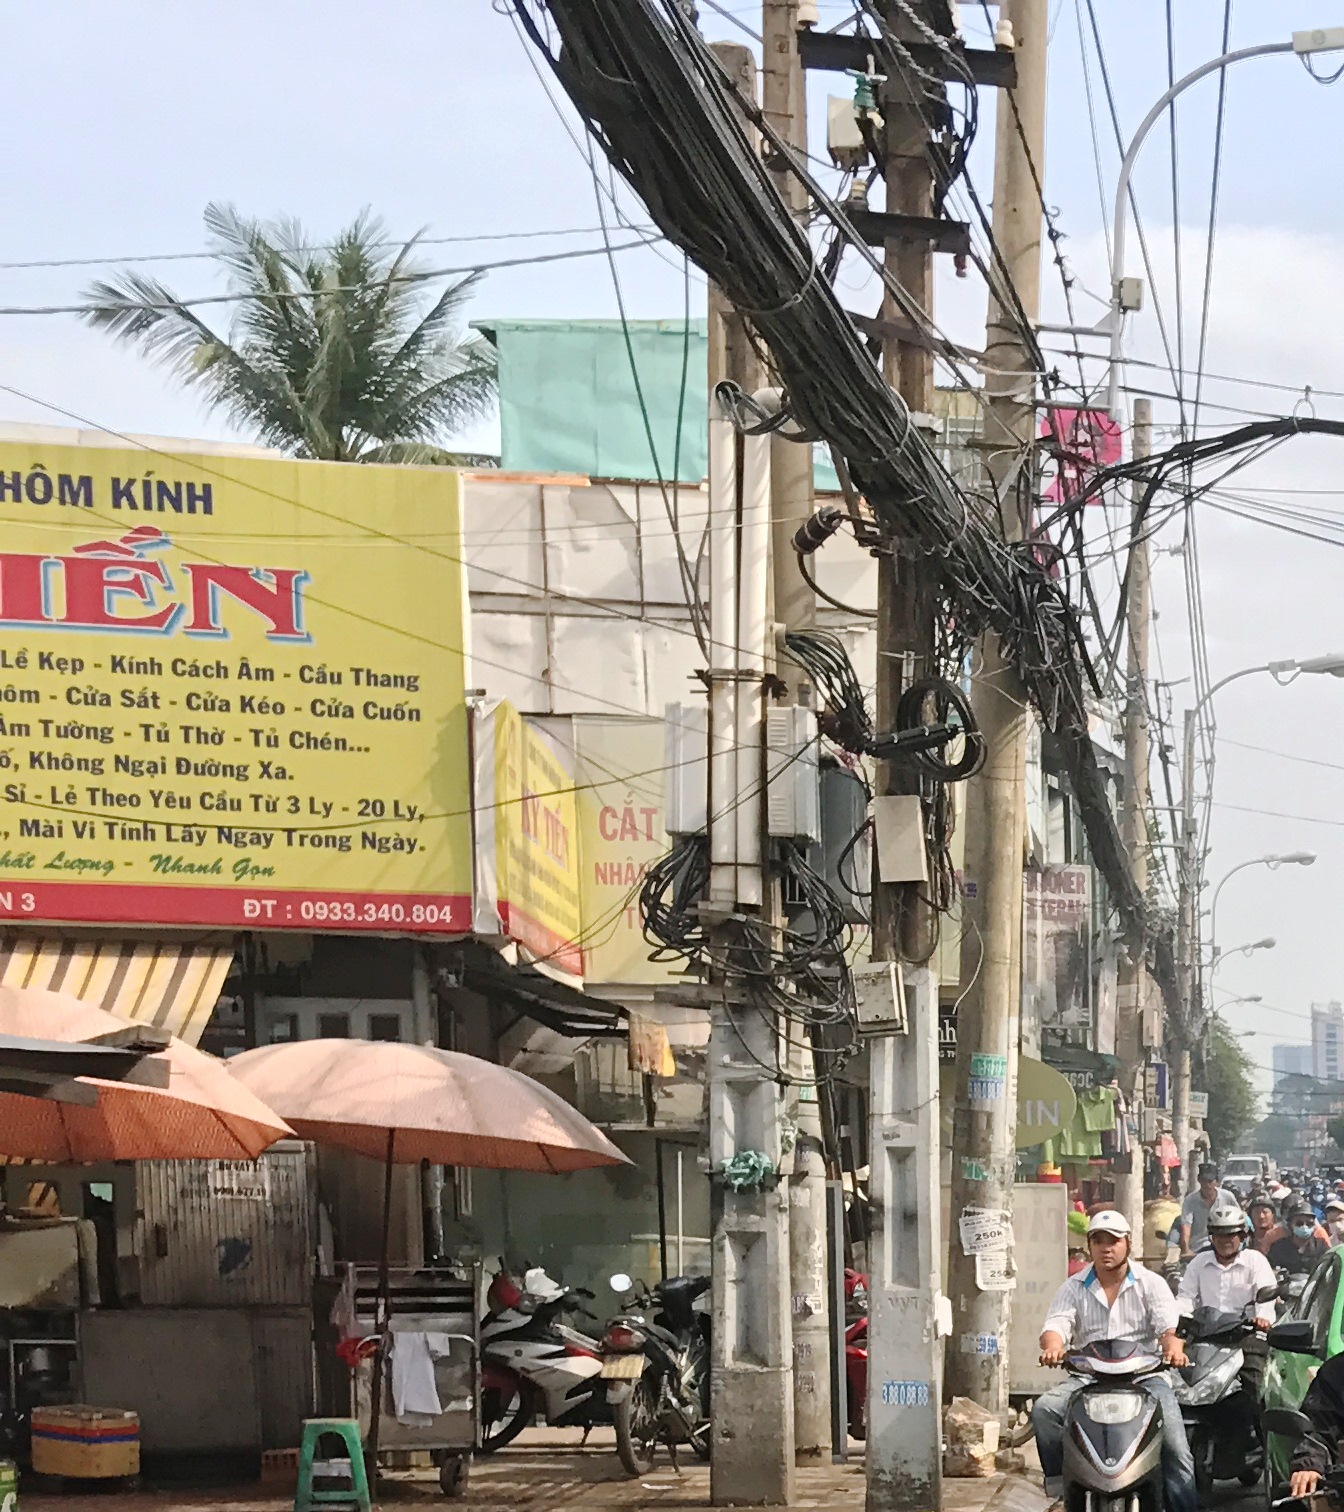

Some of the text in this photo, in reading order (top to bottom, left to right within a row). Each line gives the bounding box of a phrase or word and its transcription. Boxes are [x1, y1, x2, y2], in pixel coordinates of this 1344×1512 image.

[0, 463, 214, 516] HÔM KÍNH
[0, 526, 309, 641] IẾN
[38, 651, 420, 692] Kẹp Kính Cách Âm Thang
[66, 685, 111, 707] Cửa
[186, 691, 230, 713] Cửa
[240, 695, 286, 716] Kéo
[310, 697, 354, 719] Cửa
[363, 701, 421, 722] Cuốn
[38, 719, 370, 753] Tường Tủ Thờ Tủ Chén...
[29, 751, 294, 782] Không Ngại Đường Xa.
[51, 784, 425, 823] Lẻ Theo Yêu Từ 3 Ly 20 Ly,
[599, 791, 658, 842] CẮT
[20, 819, 426, 854] Mài Vi Tính Lấy Ngay Trong Ngày.
[43, 851, 275, 881] Lượng Nhanh Gọn
[21, 892, 452, 923] 3 ĐT 0933.340.804
[974, 1230, 1003, 1241] 250k
